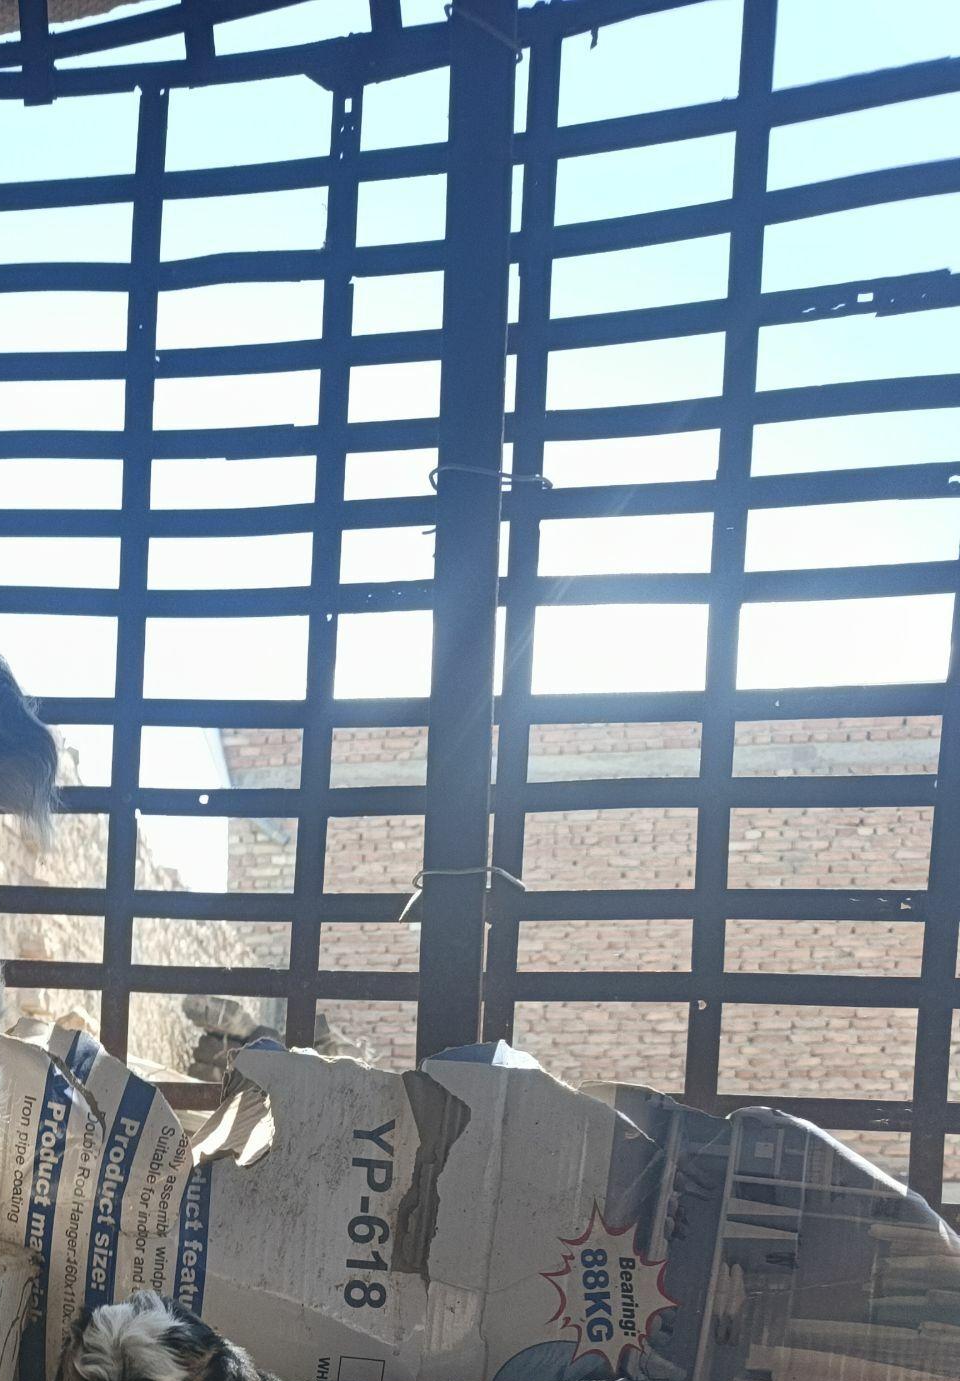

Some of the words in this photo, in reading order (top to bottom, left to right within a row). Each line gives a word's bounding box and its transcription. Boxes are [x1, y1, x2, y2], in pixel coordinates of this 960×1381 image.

[20, 1095, 37, 1128] Iron
[12, 1131, 31, 1166] pipe
[33, 1100, 67, 1208] Product
[97, 1116, 141, 1224] Product
[146, 1125, 176, 1184] Suitable
[6, 1170, 25, 1224] coating
[73, 1166, 90, 1199] Rod
[140, 1186, 156, 1207] for
[343, 1118, 397, 1309] YP-618
[90, 1232, 113, 1291] size:
[132, 1256, 145, 1284] and
[178, 1240, 203, 1312] featu
[580, 1248, 614, 1343] 88KG
[618, 1256, 637, 1338] Bearing:
